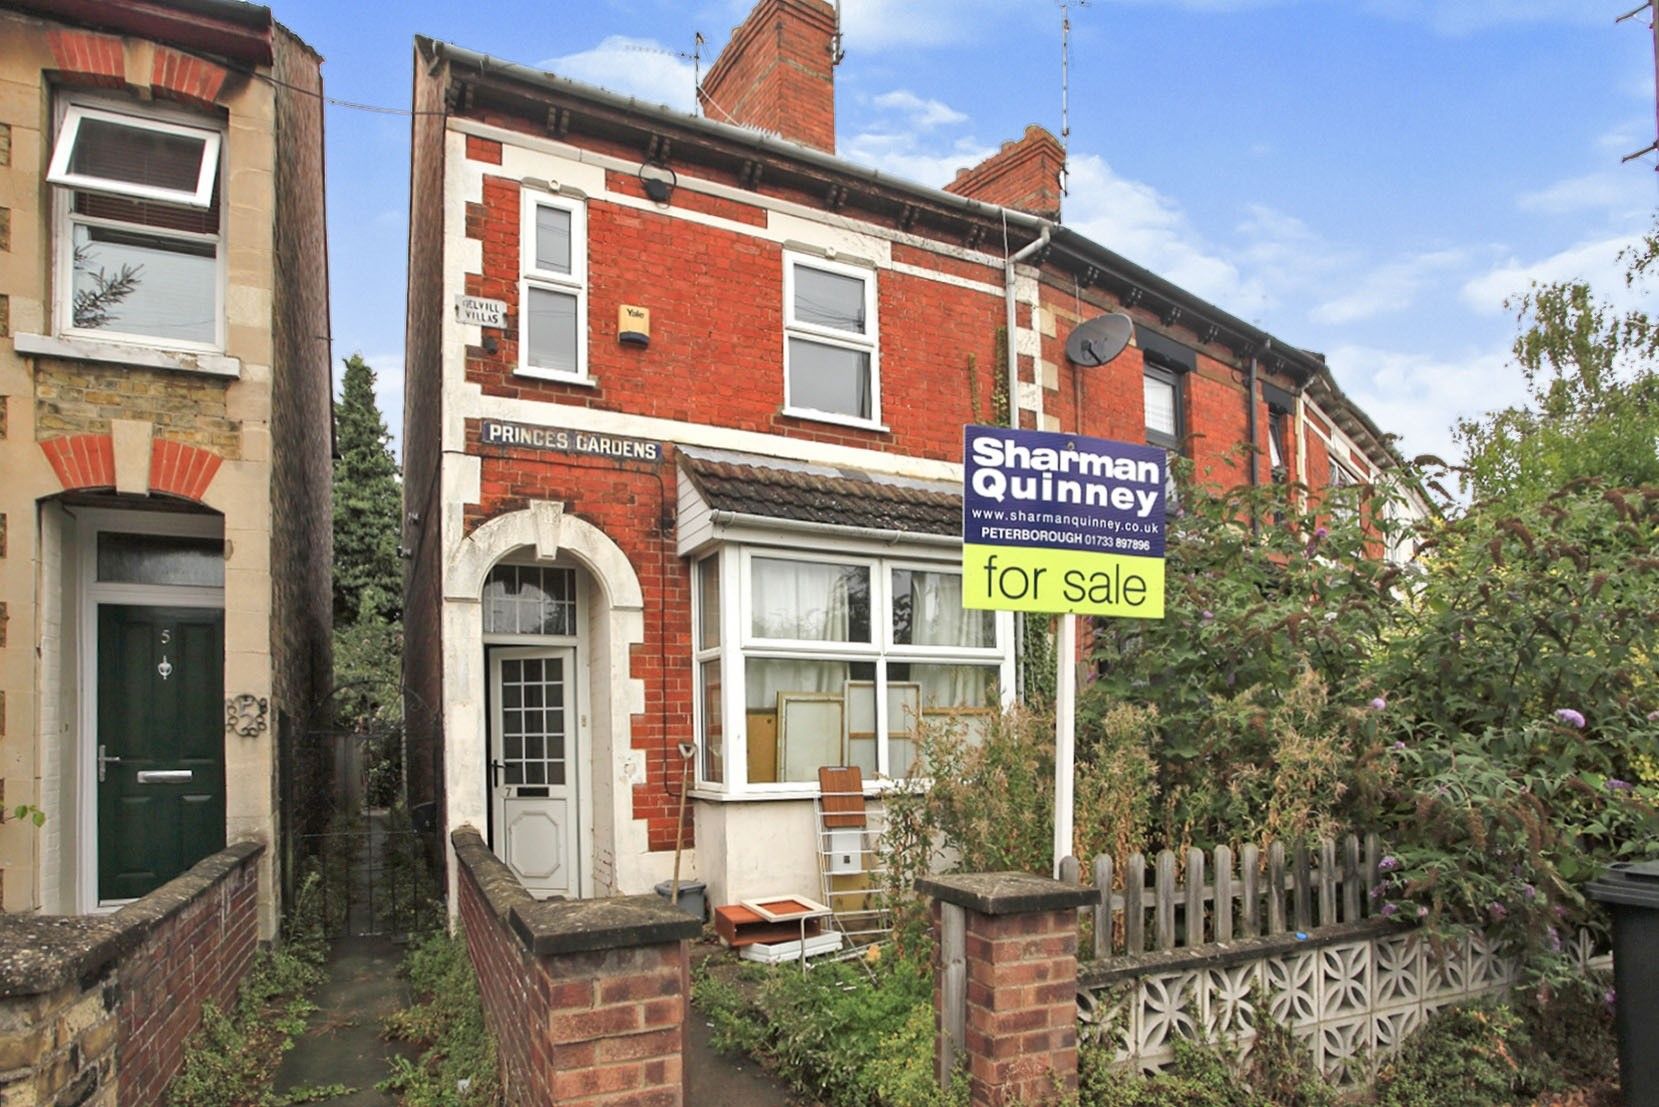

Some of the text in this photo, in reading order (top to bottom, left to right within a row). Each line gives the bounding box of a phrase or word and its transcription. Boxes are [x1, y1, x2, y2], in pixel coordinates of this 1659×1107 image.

[465, 310, 498, 324] VILLAS
[627, 308, 645, 319] Yale
[489, 423, 657, 460] PRINCES GARDENS
[972, 436, 1159, 484] Sharman
[972, 468, 1158, 518] Quinney
[971, 508, 1159, 534] www.sharmanquinney.co.uk
[981, 526, 1151, 551] PETERBOROUGH 01733 897896
[984, 555, 1147, 606] for sale
[161, 629, 170, 644] 5
[504, 786, 512, 797] 7
